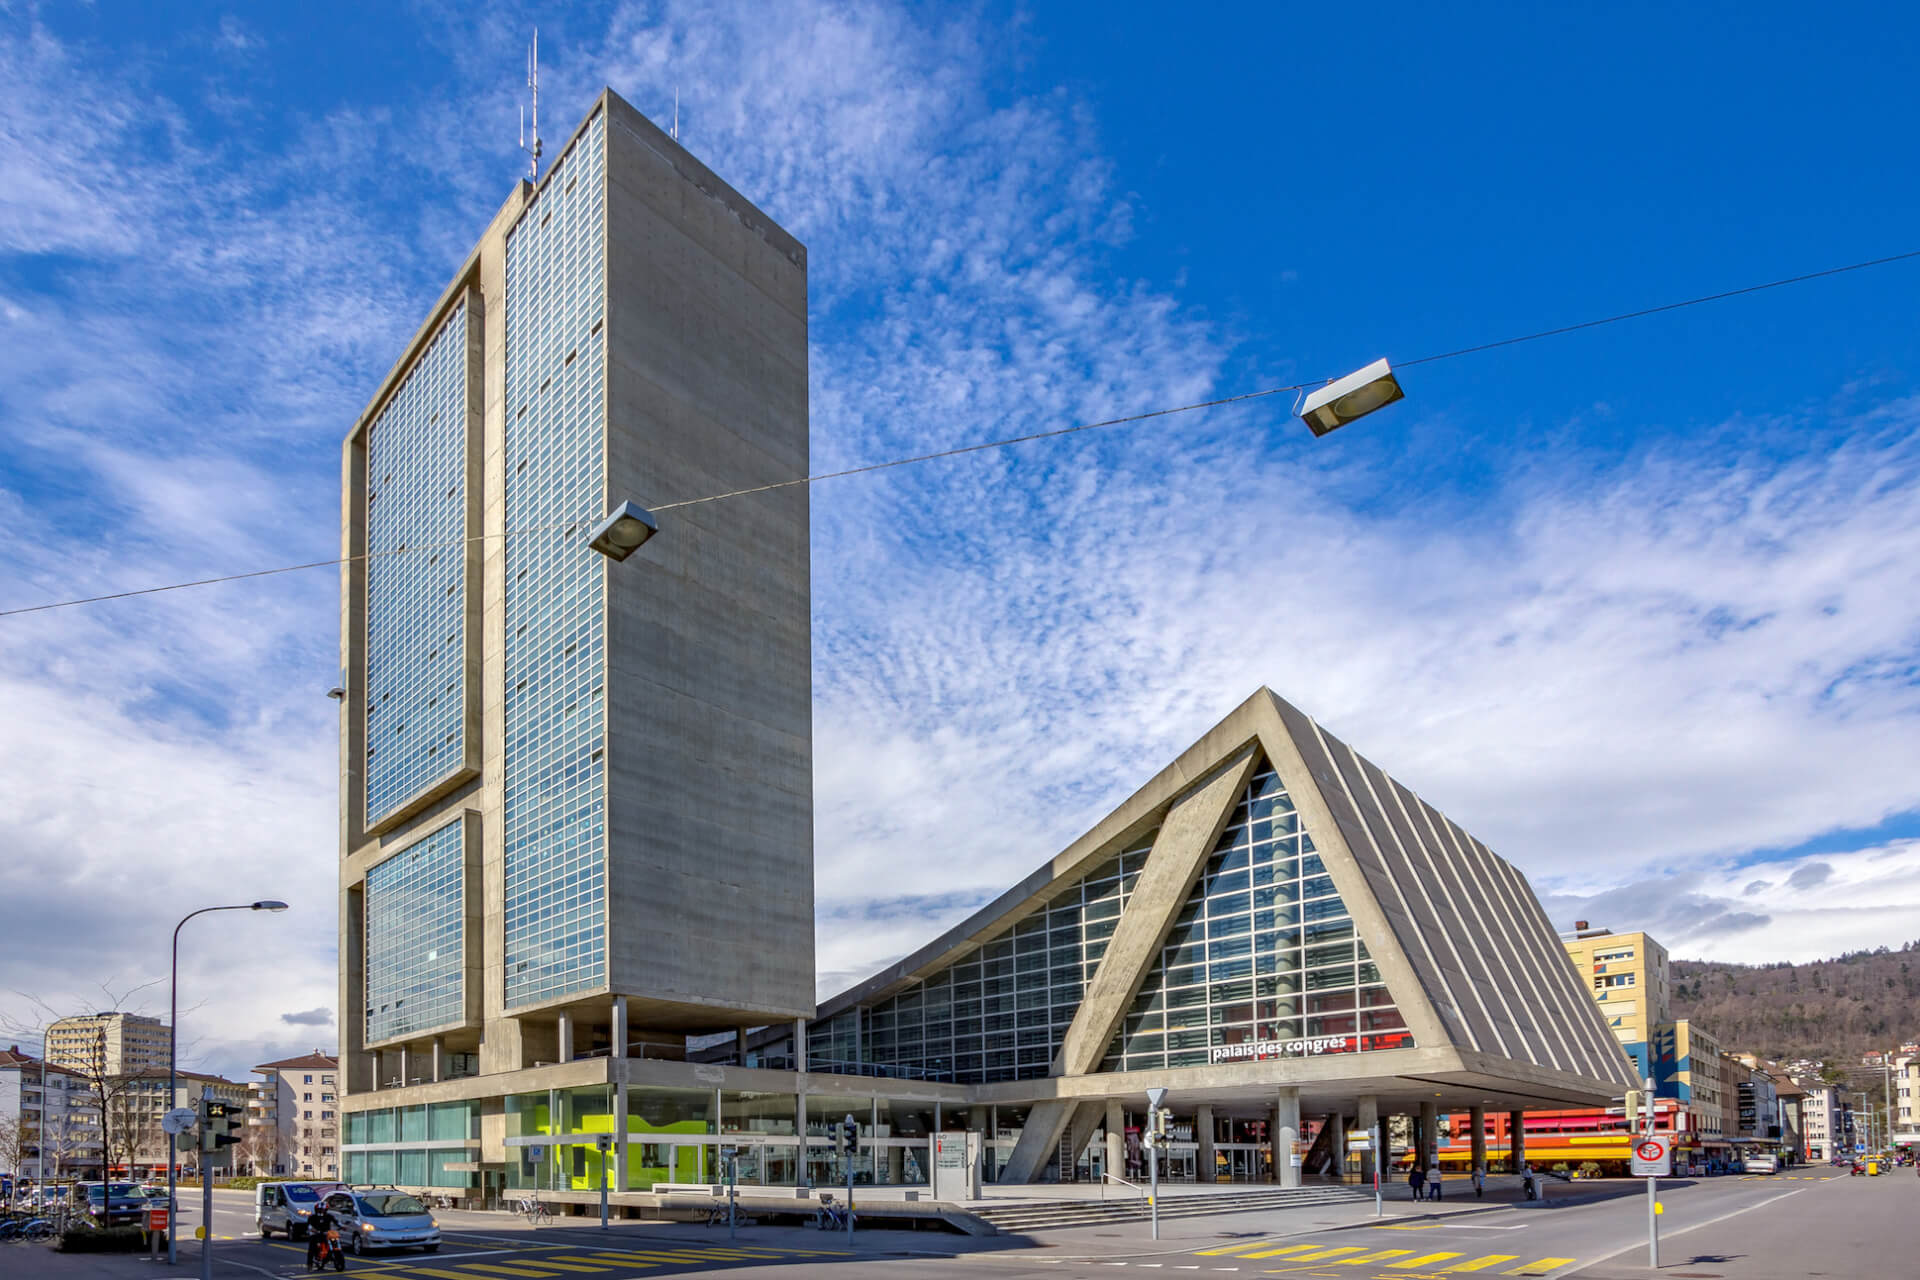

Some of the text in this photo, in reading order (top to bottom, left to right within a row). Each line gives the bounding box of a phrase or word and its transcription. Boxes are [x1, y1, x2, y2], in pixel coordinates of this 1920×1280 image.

[1213, 1036, 1346, 1061] palais des congrès
